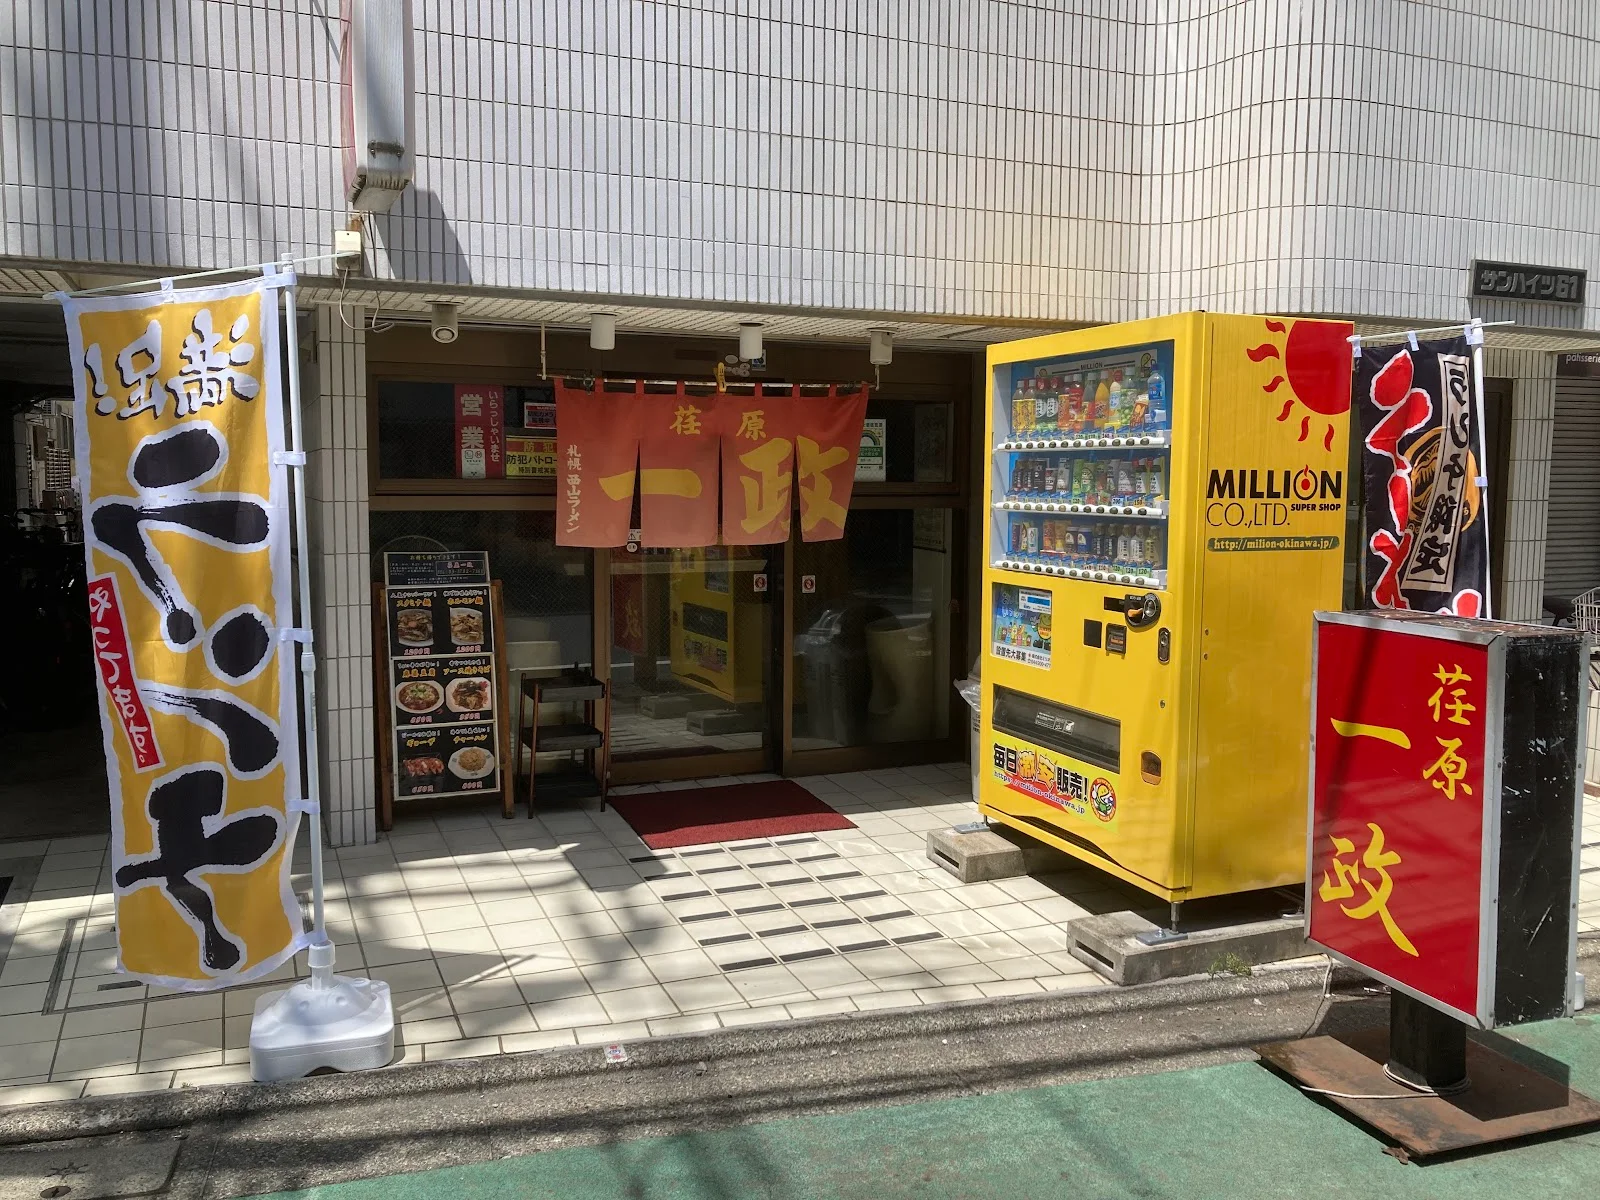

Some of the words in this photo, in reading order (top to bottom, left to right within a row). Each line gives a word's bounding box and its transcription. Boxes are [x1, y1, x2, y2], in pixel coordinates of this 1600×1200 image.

[1480, 269, 1579, 300] サンハイツ61
[460, 393, 484, 449] 営業
[488, 390, 500, 463] いらっしゃいませ
[598, 434, 850, 537] 一政
[1206, 466, 1342, 501] MILLION
[1206, 502, 1291, 529] CO.,LTD.
[1290, 504, 1317, 512] SUPER
[1318, 504, 1341, 512] SHOP
[1213, 538, 1334, 551] http://milion-okinawa.jp/
[996, 645, 1027, 662] 設置先大募集
[1422, 661, 1475, 802] 荏原
[1318, 716, 1421, 957] 一政
